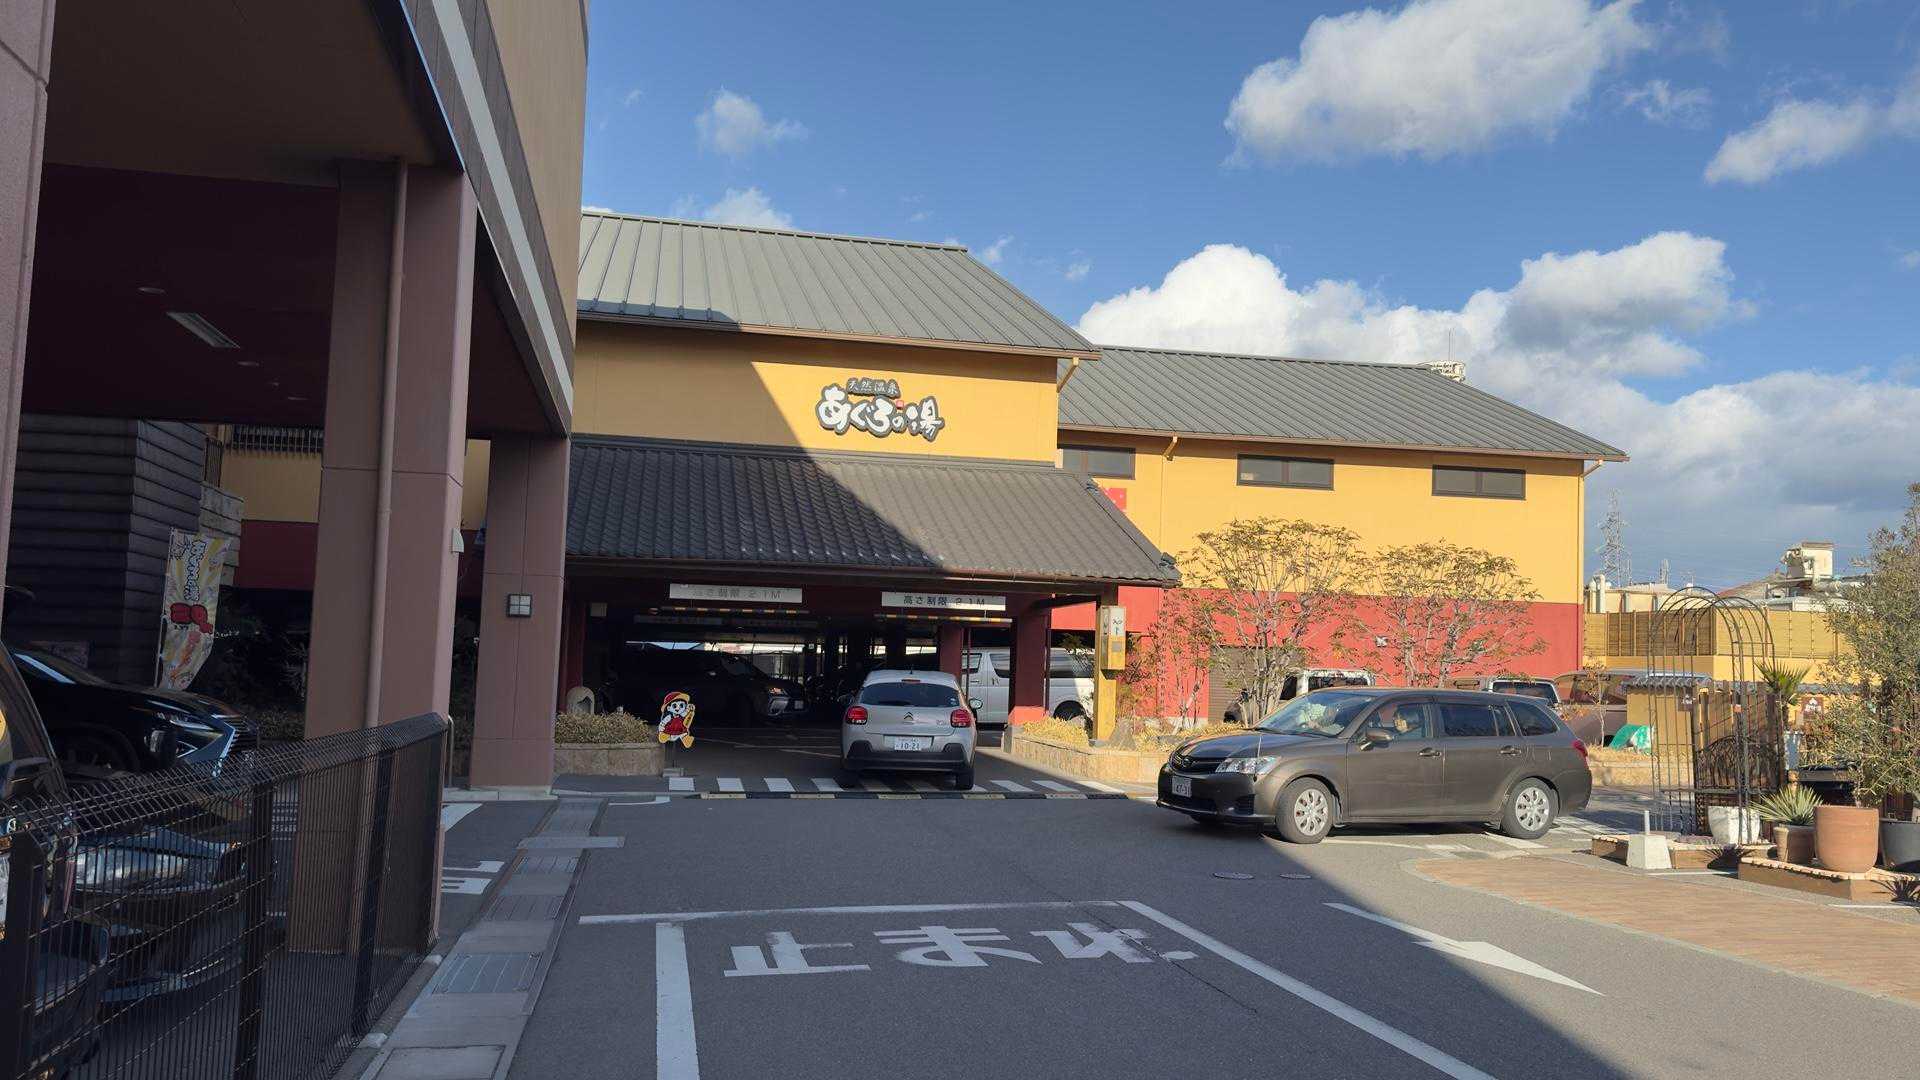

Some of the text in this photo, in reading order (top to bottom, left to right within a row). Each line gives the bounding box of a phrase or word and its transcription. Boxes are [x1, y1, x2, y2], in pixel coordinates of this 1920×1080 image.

[847, 379, 899, 396] 天然温泉
[724, 921, 1198, 977] 止まれ
